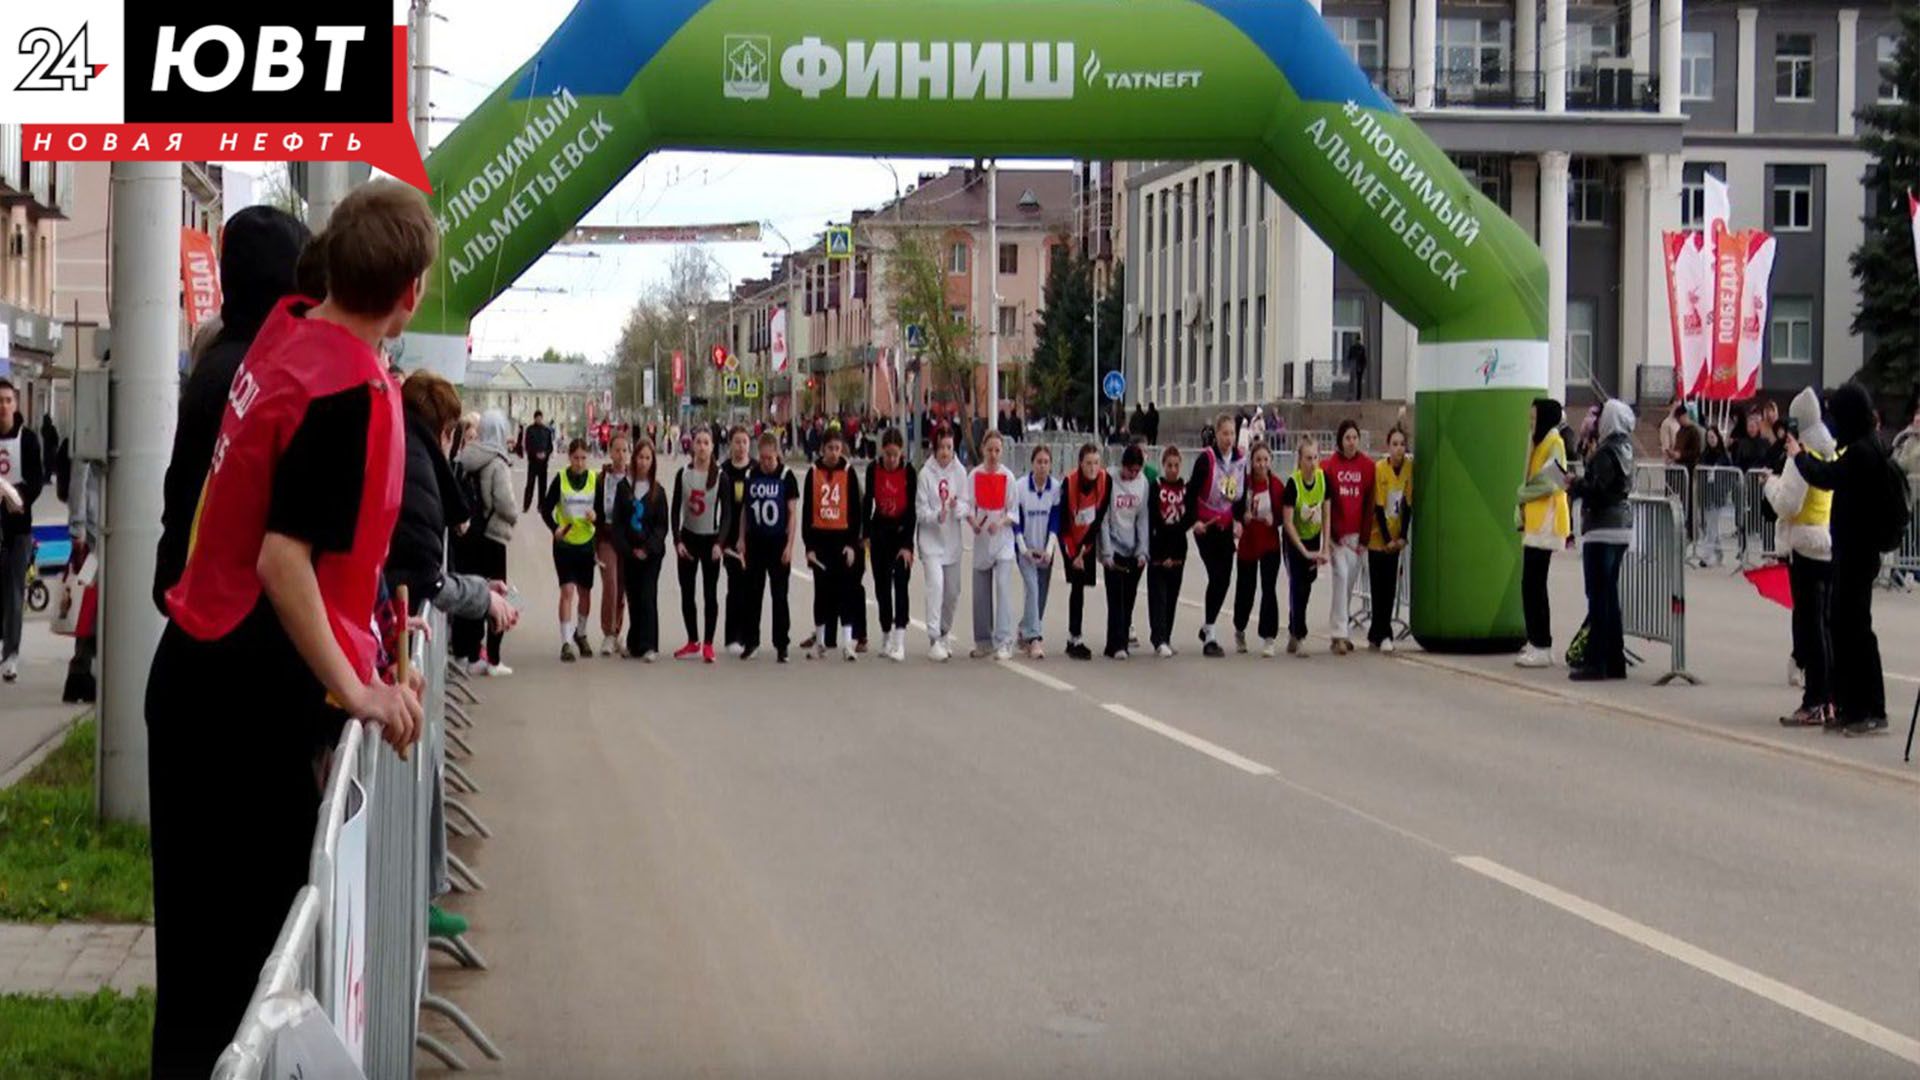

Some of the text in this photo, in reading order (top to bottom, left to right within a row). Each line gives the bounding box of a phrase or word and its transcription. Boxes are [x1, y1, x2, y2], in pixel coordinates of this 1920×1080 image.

[780, 36, 1075, 99] ФИНИШ
[1103, 71, 1203, 89] TATNEFT
[435, 85, 579, 236] #ЛЮБИМЫЙ
[1343, 99, 1481, 248] #ЛЮБИМЫЙ
[449, 109, 614, 284] АЛЬМЕТЬЕВСК
[1304, 117, 1468, 291] АЛЬМЕТЬЕВСК
[187, 251, 215, 323] БЕДА!
[1718, 255, 1738, 344] ПОБЕДА!
[688, 489, 707, 517] 5
[750, 483, 779, 498] СОШ
[820, 483, 841, 506] 24
[1337, 470, 1362, 483] СОШ
[751, 500, 779, 526] 10
